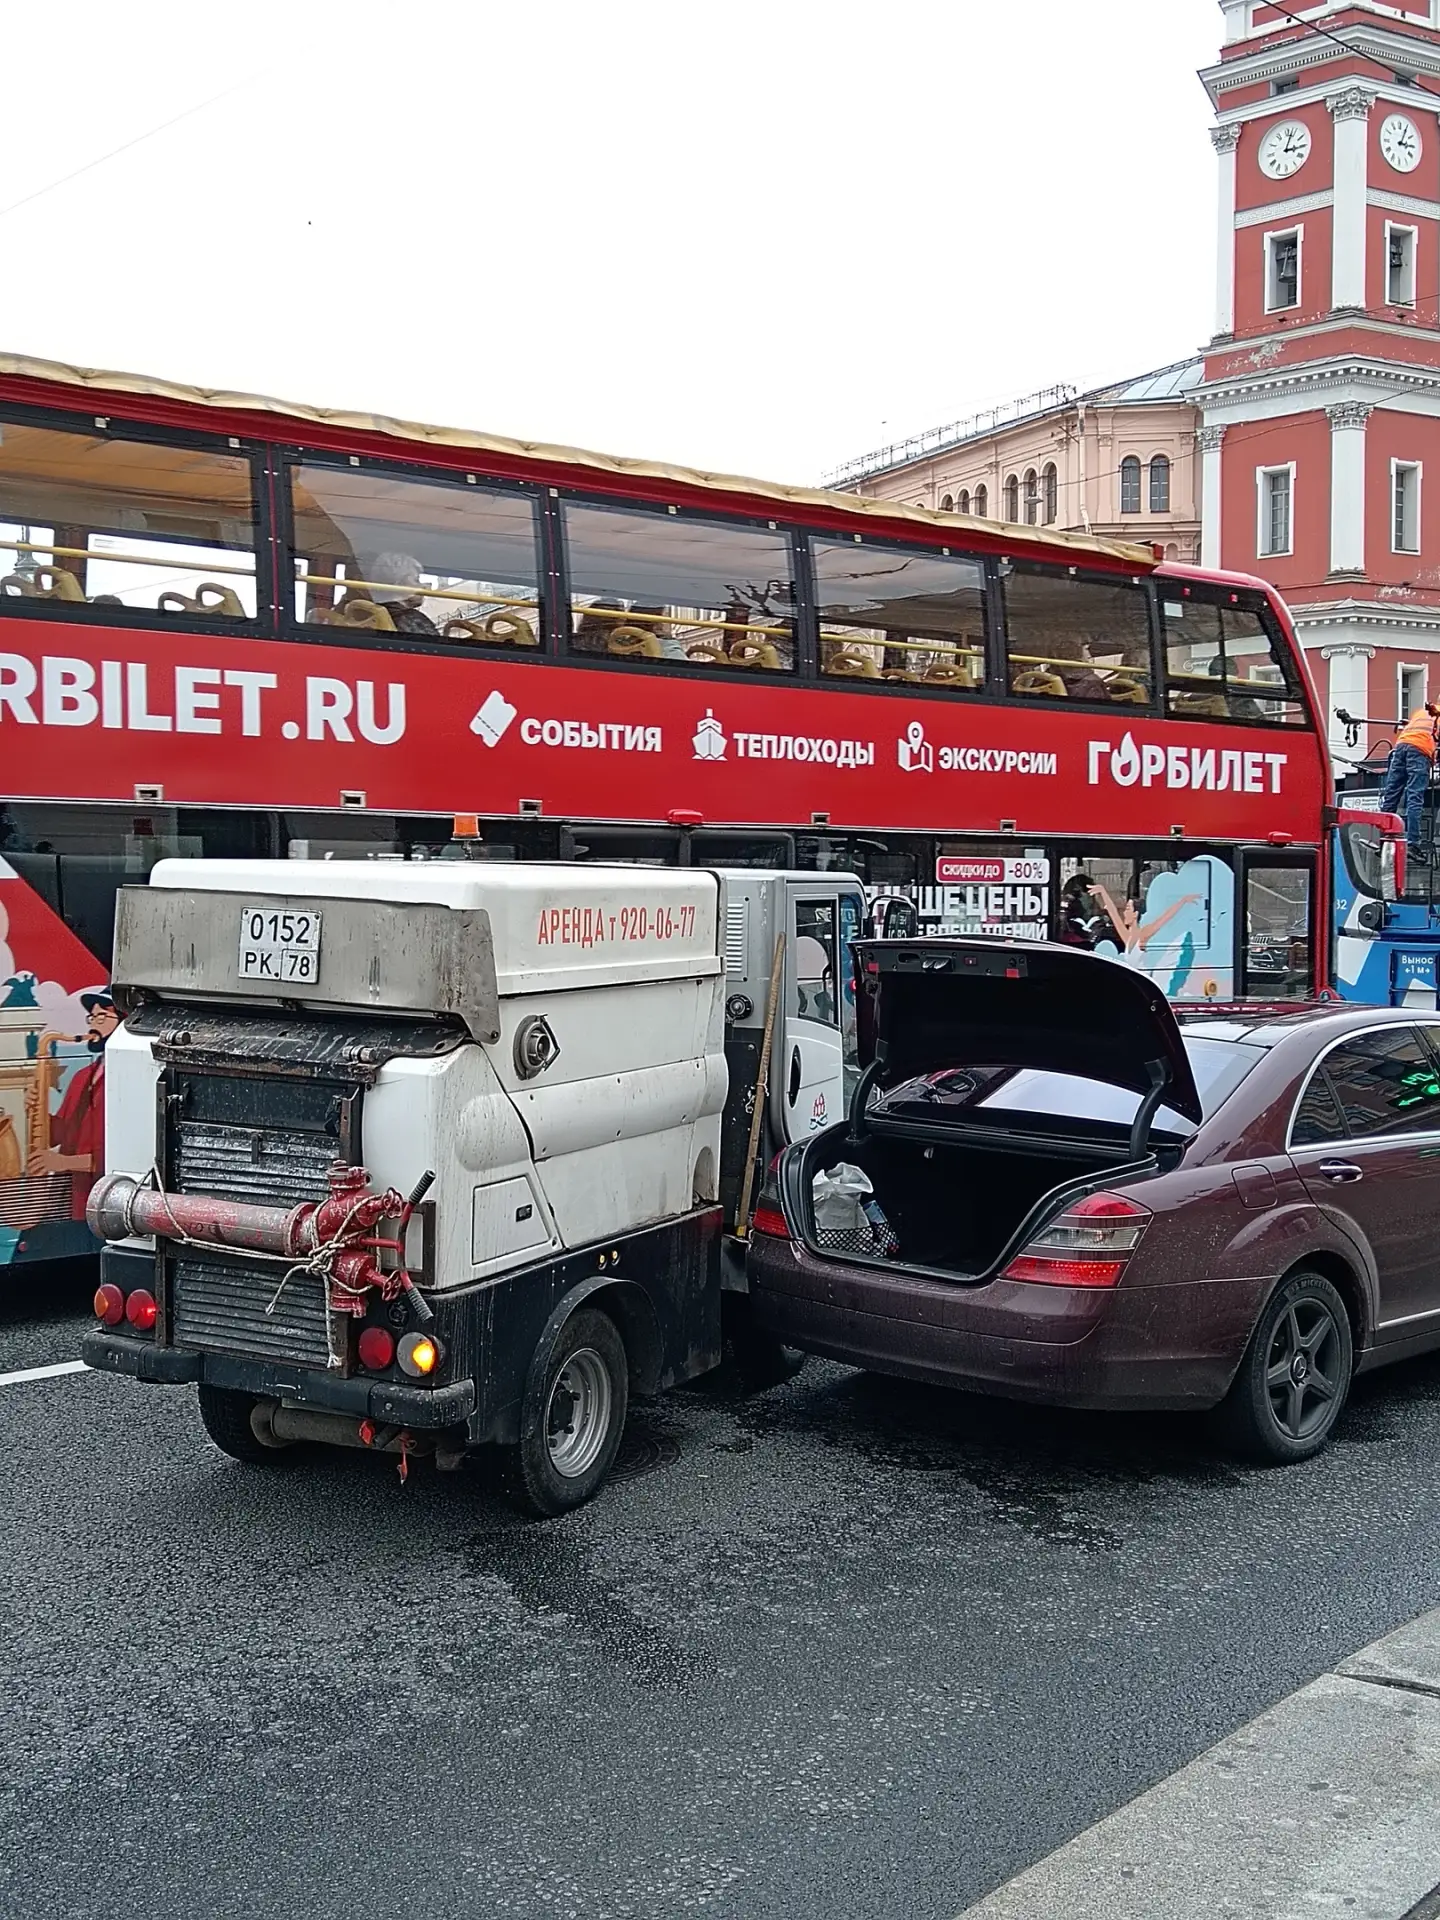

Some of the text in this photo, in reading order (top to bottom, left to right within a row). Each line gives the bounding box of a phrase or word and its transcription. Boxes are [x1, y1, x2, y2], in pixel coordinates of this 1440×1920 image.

[520, 717, 662, 752] СОБЫТИЯ
[733, 732, 874, 769] ТЕПЛОХОДЫ
[938, 745, 1057, 775] ЭКСКУРСИИ
[1088, 731, 1288, 794] ГОРБИЛЕТ
[942, 862, 1043, 879] СКИДКИ ДО -80%
[966, 886, 1049, 921] ЦЕНЫ
[250, 913, 310, 944] 0152
[538, 907, 604, 948] АРЕНДА
[621, 905, 696, 941] 920-06-77
[288, 954, 310, 977] 78
[1401, 955, 1434, 964] Вынос
